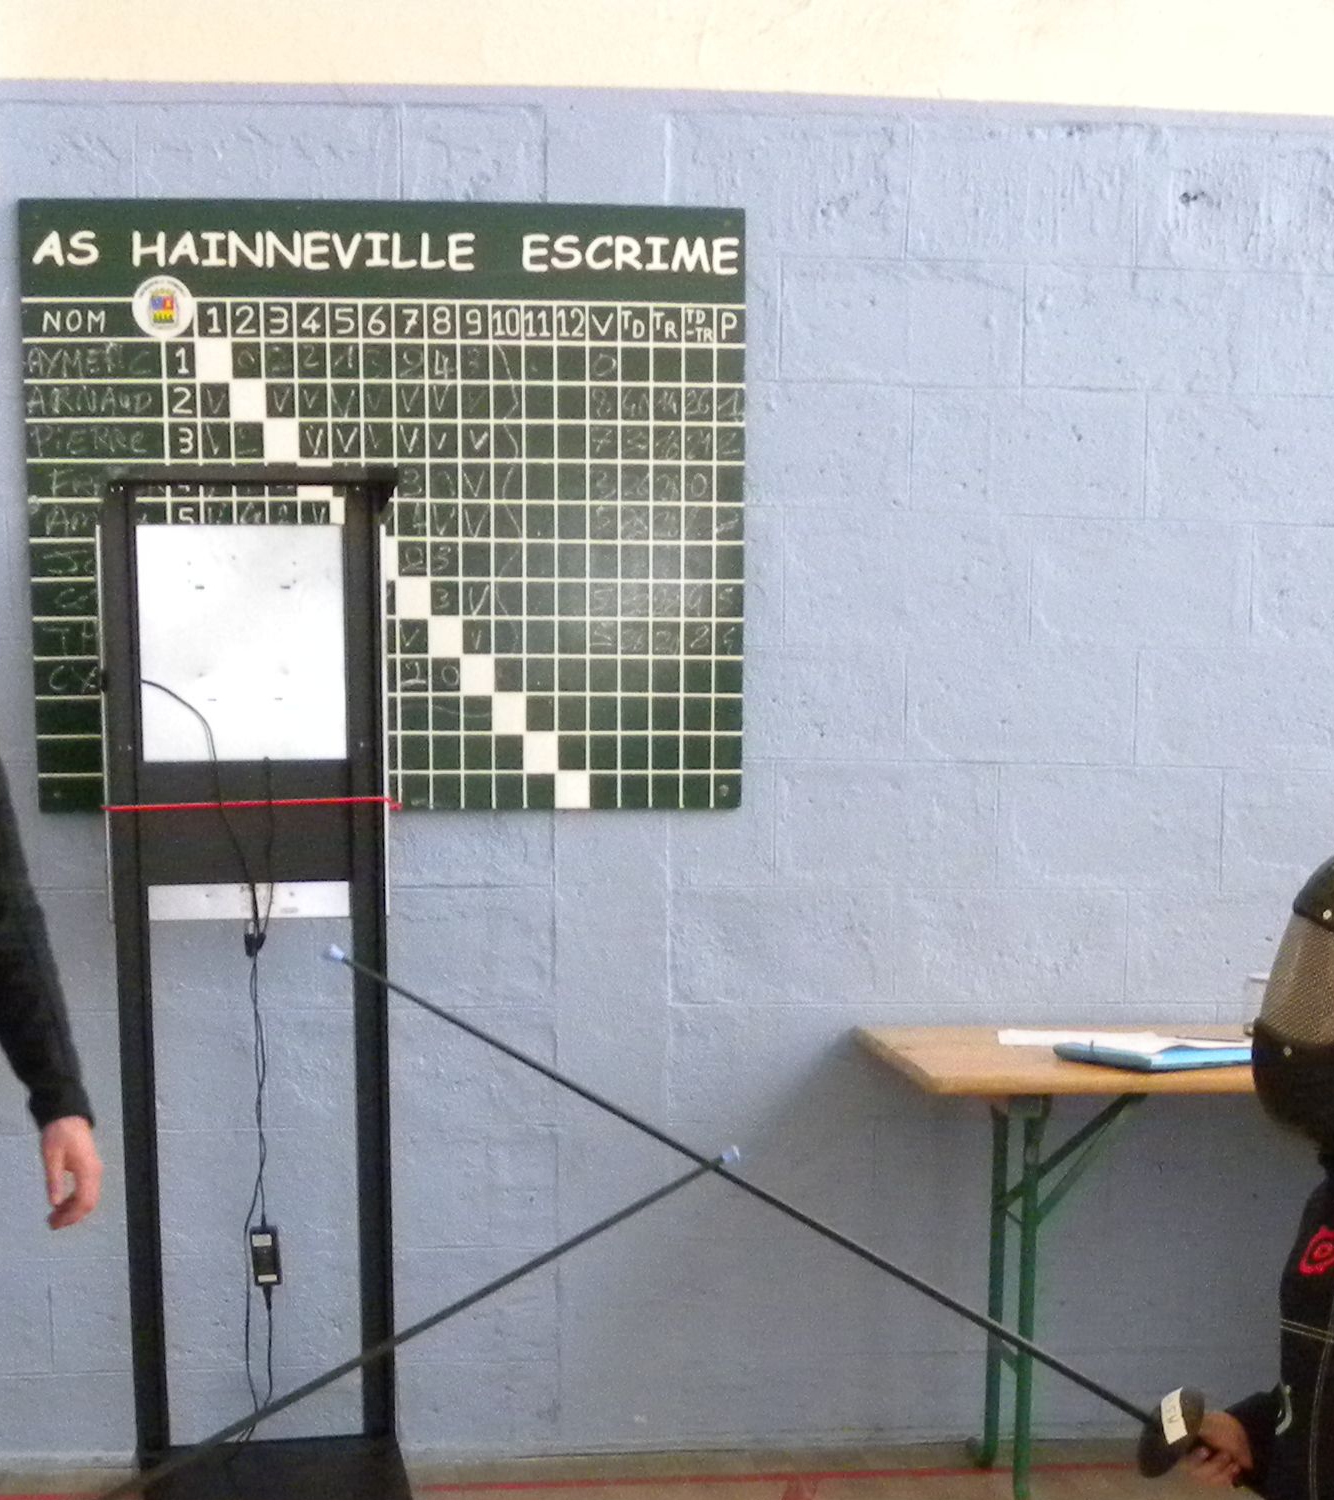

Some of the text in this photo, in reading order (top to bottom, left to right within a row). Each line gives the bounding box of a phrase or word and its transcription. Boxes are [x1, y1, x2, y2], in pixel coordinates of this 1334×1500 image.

[32, 230, 740, 275] AS HAINNEVILLE ESCRIME
[42, 309, 106, 334] NOM
[206, 306, 223, 335] 1
[235, 305, 256, 335] 2
[269, 306, 289, 335] 3
[301, 306, 322, 334] 4
[334, 307, 355, 335] 5
[367, 306, 387, 336] 6
[402, 308, 419, 335] 7
[432, 306, 451, 335] 8
[465, 308, 482, 336] 9
[492, 308, 520, 337] 10
[524, 309, 551, 337] 11
[557, 308, 585, 337] 12
[591, 312, 614, 337] V
[721, 311, 738, 341] P
[175, 347, 190, 375] 1
[171, 387, 193, 415] 2
[178, 427, 195, 455] 3
